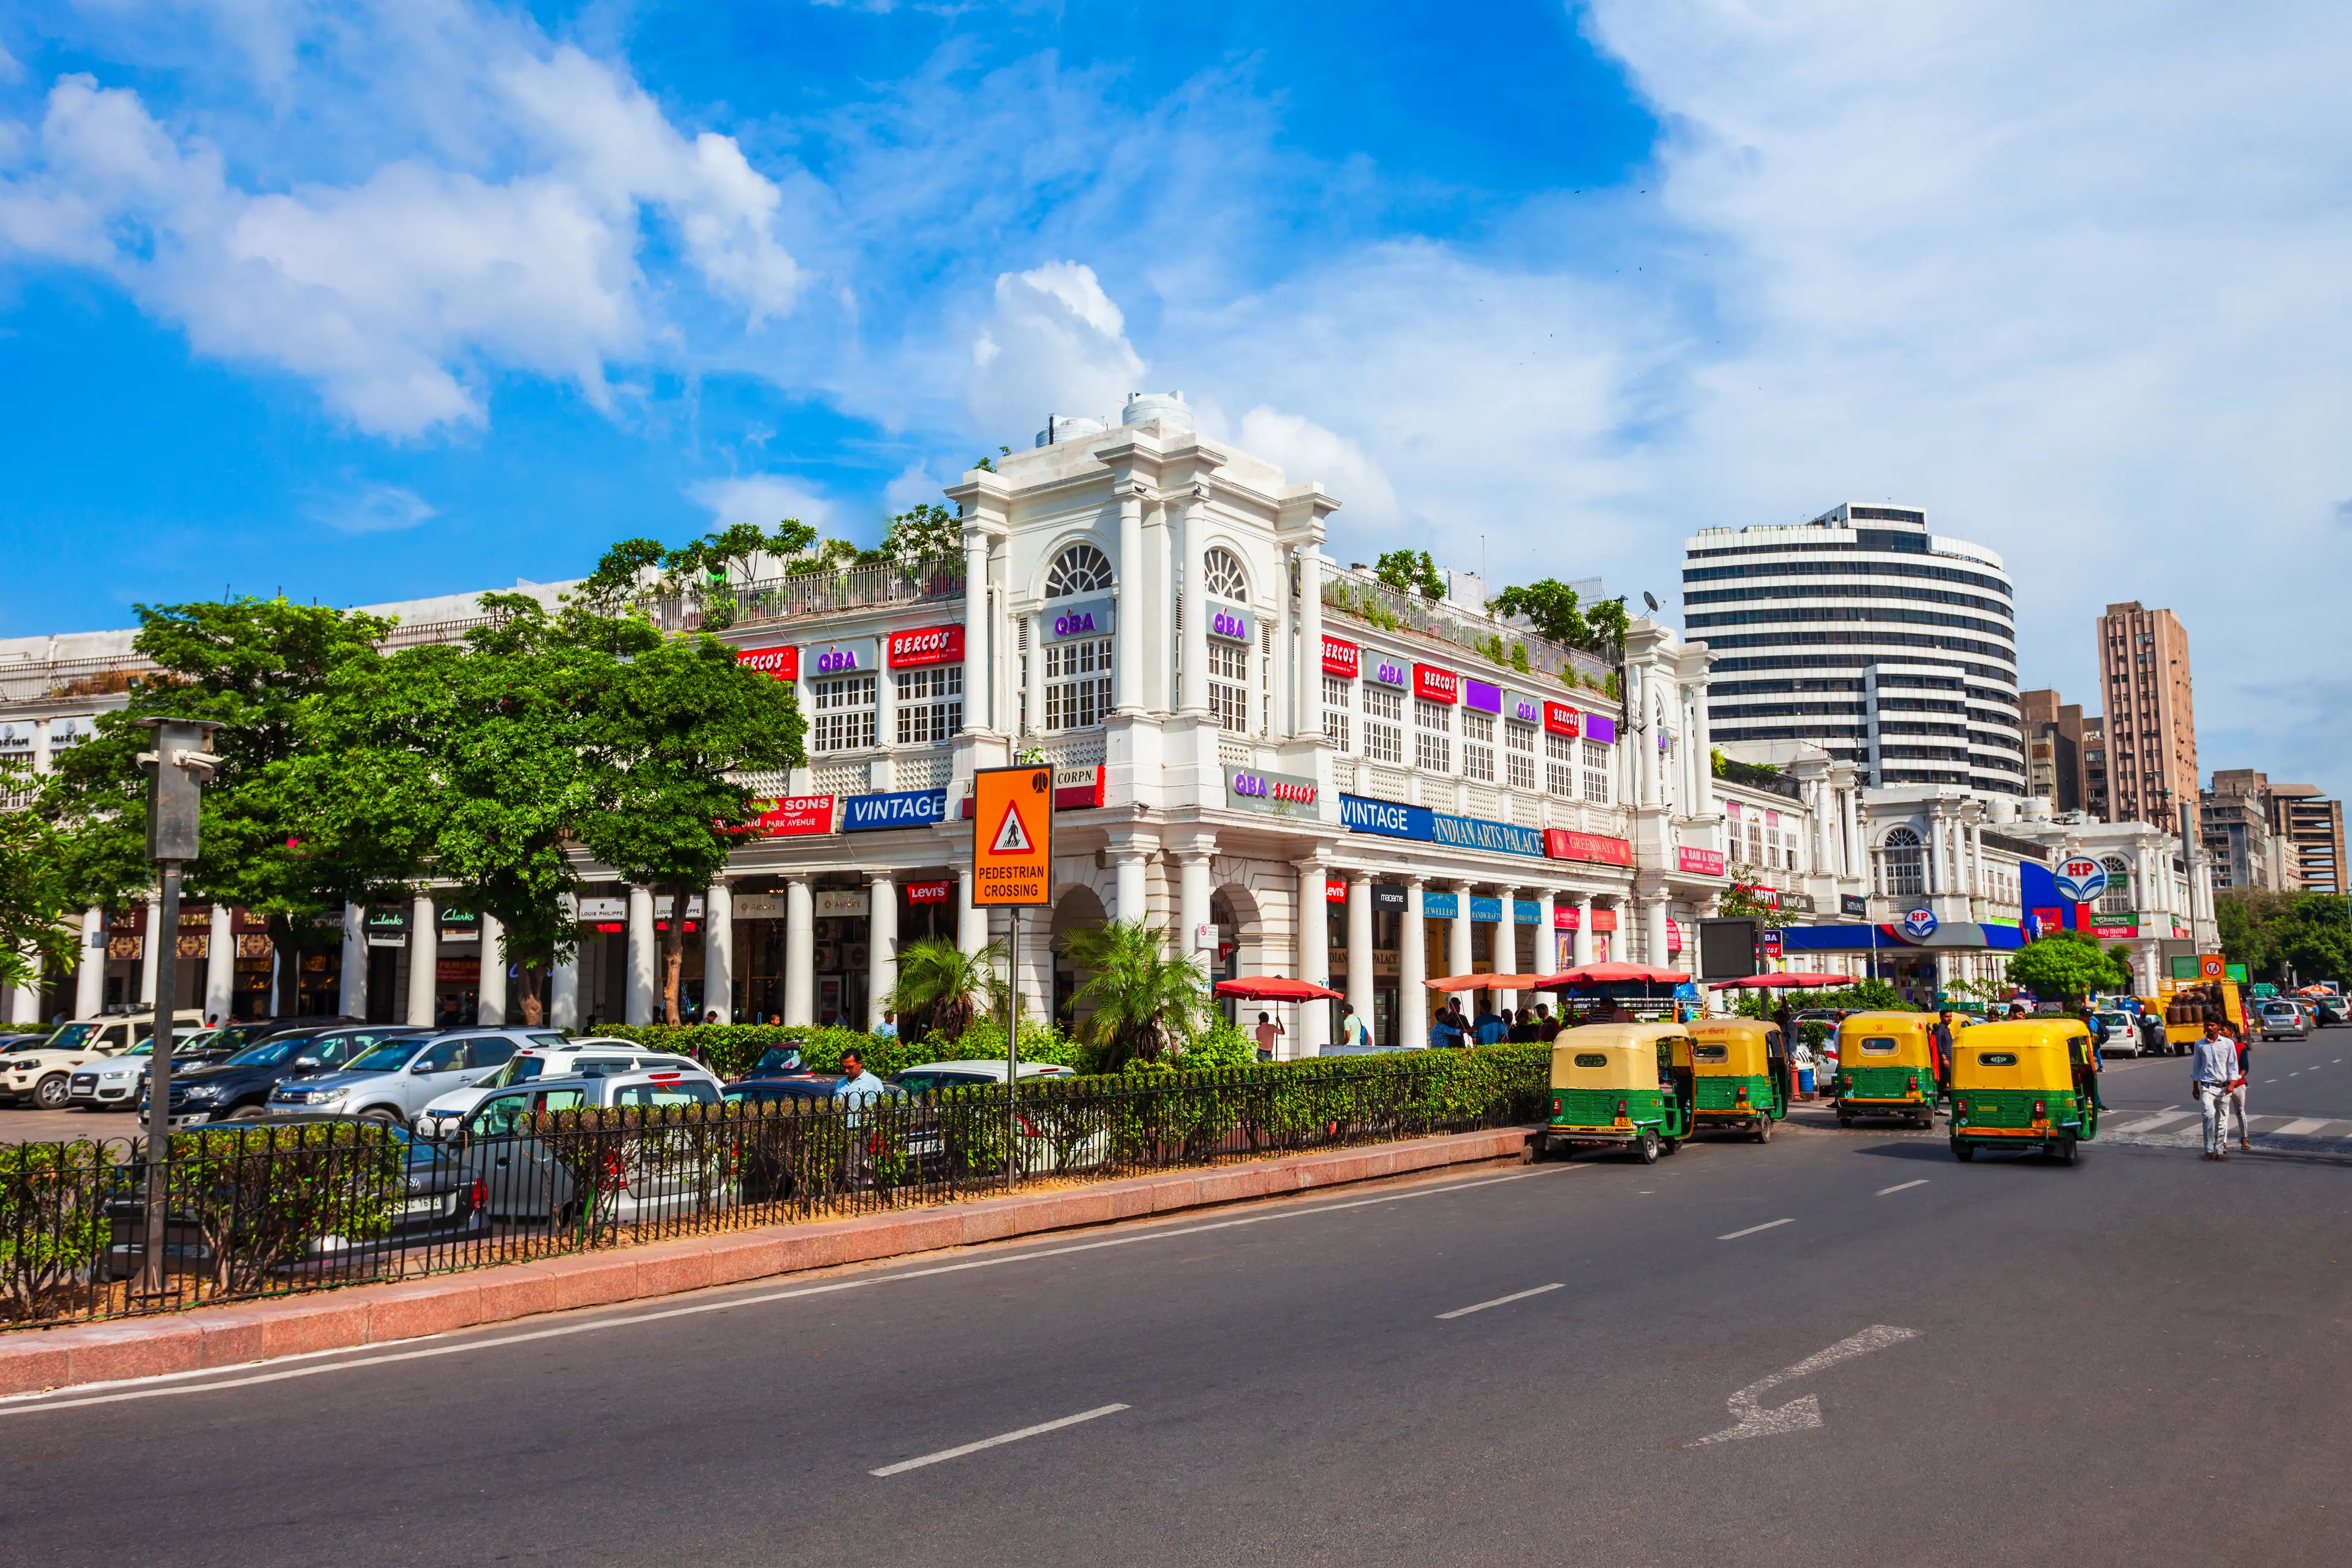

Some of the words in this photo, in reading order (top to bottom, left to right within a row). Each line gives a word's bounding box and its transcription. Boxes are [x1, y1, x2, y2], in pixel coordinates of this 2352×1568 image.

[894, 631, 949, 655] BERCO'S
[1424, 671, 1455, 692] BERCO'S
[1553, 707, 1578, 726] BERCO'S
[1057, 769, 1095, 785] CORPN.
[1272, 782, 1315, 804] BERCO'S
[785, 797, 829, 811] SONS
[855, 794, 946, 821] VINTAGE
[1341, 799, 1408, 831] VINTAGE
[767, 820, 785, 828] PARK
[787, 818, 816, 827] AVENUE
[1434, 817, 1475, 846] INDIAN
[1477, 823, 1501, 848] ARTS
[1503, 826, 1542, 855] PALACE
[1569, 836, 1616, 854] GREENWAYS
[1680, 848, 1687, 859] M.
[1688, 850, 1701, 861] RAM
[1702, 851, 1707, 862] &
[1708, 852, 1722, 864] SONS
[979, 865, 1044, 880] PEDESTRIAN
[2067, 862, 2094, 876] HP
[984, 883, 1038, 898] CROSSING
[442, 908, 475, 921] Clarks
[1423, 907, 1456, 916] JEWELLERY
[1471, 911, 1501, 921] HANDICRAFTS
[1912, 912, 1928, 921] HP
[2098, 926, 2128, 937] Raymond
[1329, 952, 1348, 963] DIAN
[1844, 1089, 1855, 1099] CNG
